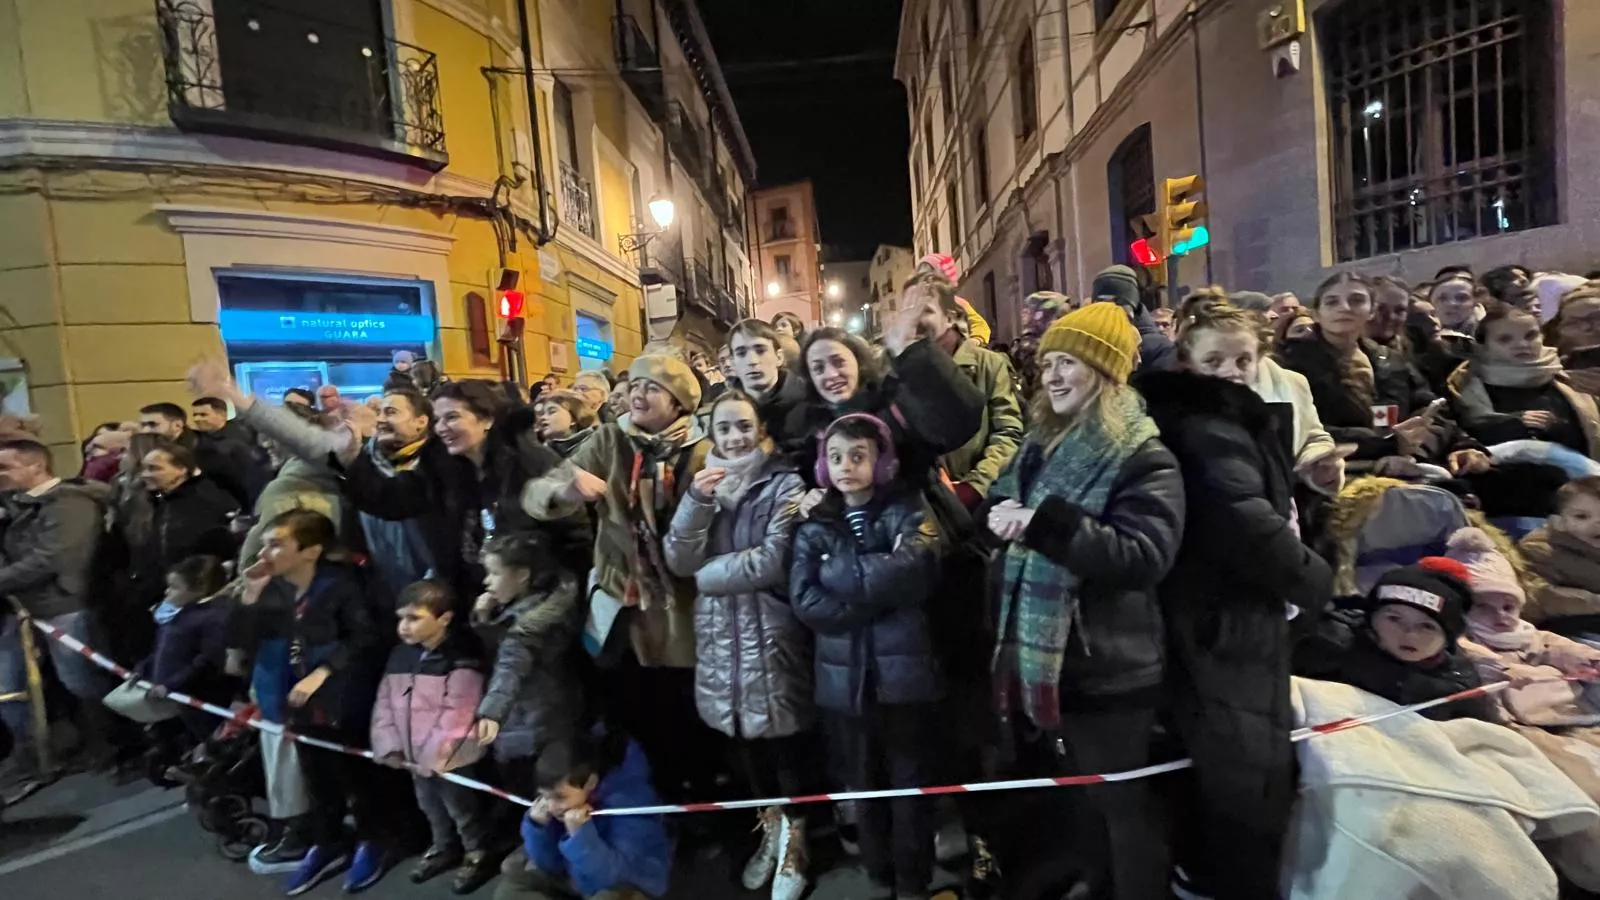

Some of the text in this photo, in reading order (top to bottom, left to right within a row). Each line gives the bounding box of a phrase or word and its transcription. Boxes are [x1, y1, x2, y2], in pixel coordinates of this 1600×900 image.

[301, 318, 386, 330] natural optics
[324, 330, 368, 339] GUARA
